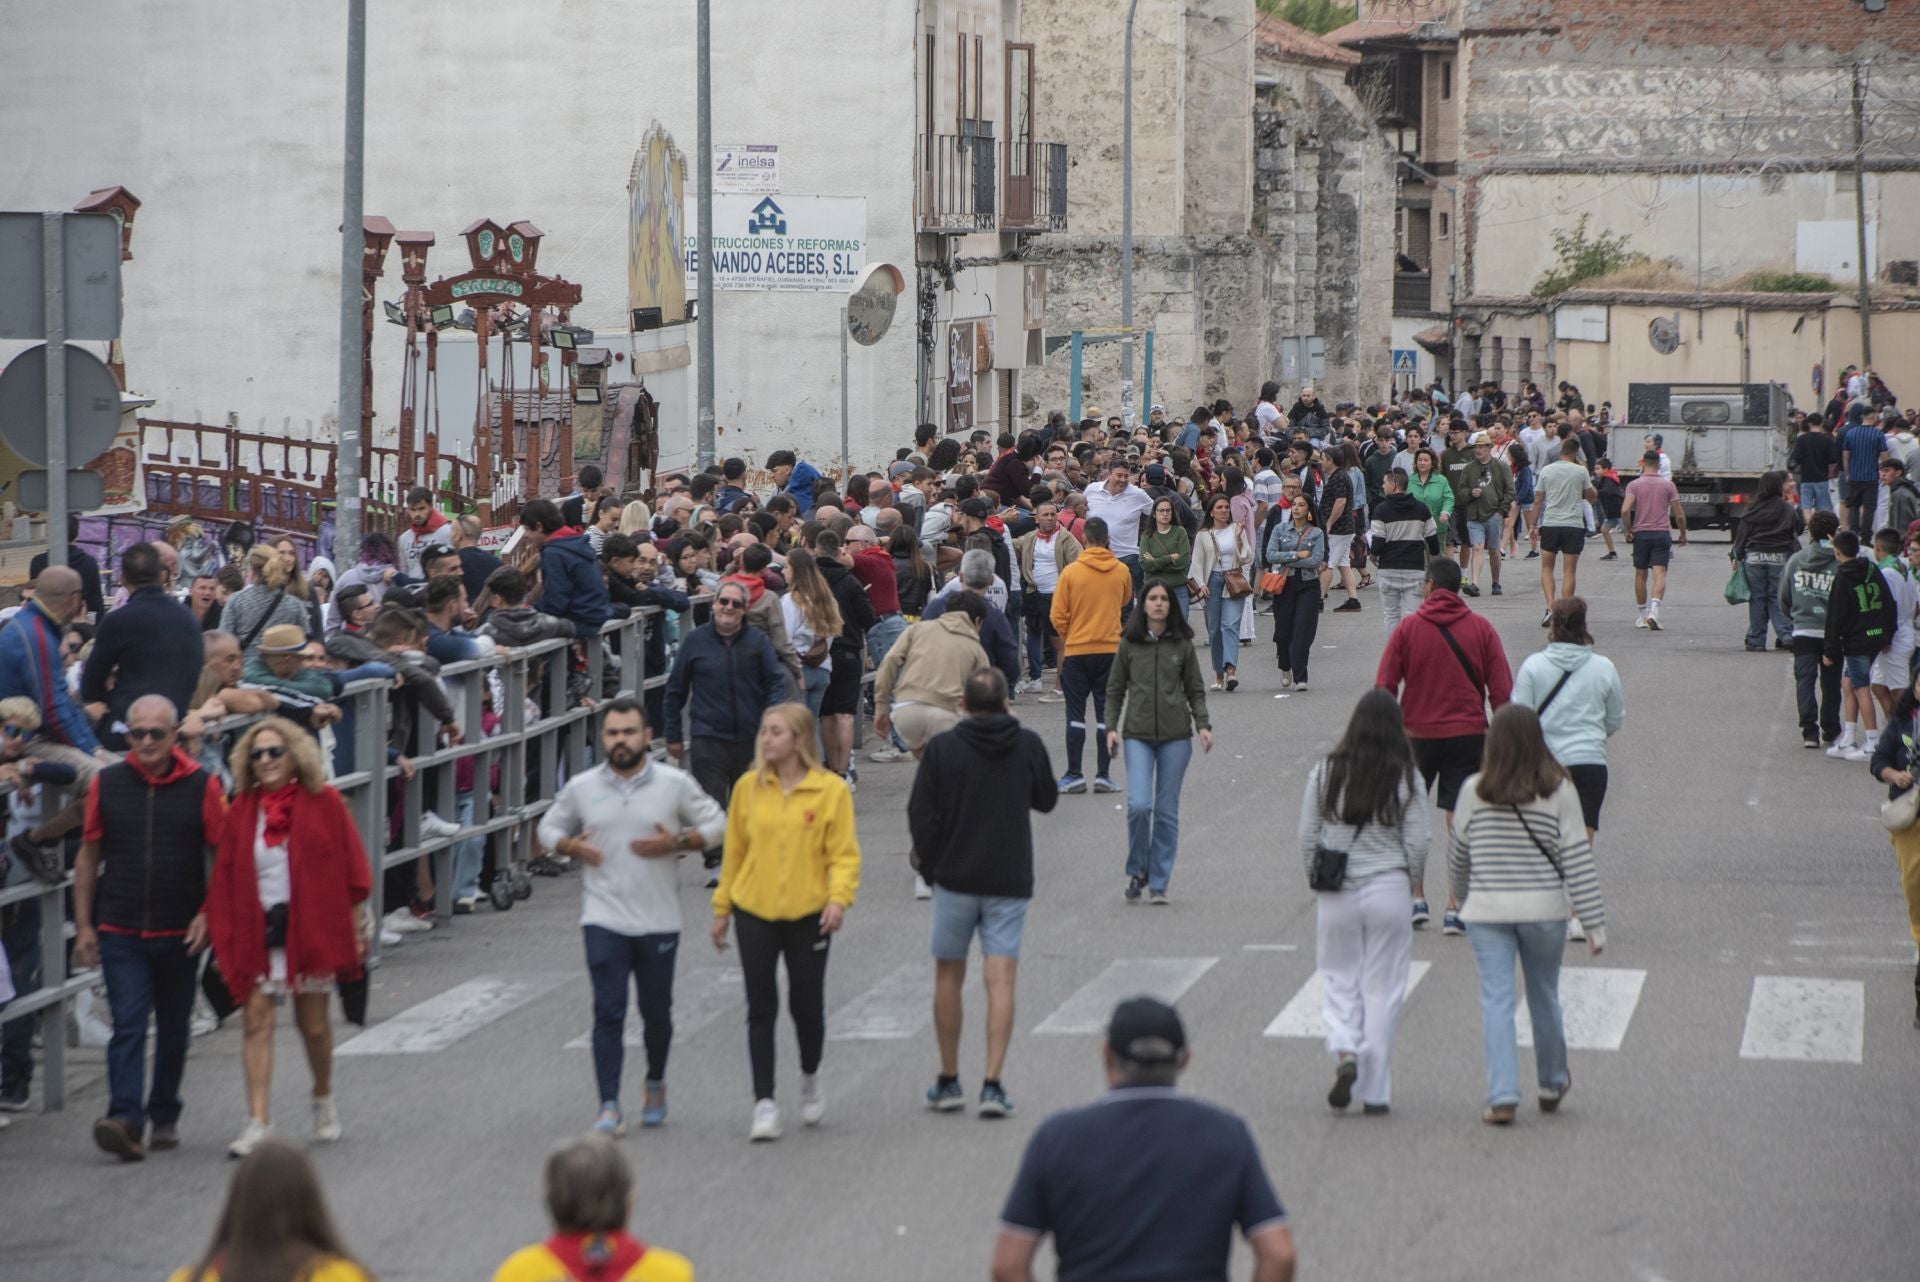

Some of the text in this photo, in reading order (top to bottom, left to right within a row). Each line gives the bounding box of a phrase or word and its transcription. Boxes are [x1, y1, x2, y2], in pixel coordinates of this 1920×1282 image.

[738, 155, 775, 167] inelsa
[684, 237, 860, 251] OTRUCCIONES Y REFORMAS
[684, 250, 858, 278] HENANDO ACEBES, S.L.
[1854, 582, 1882, 612] 12
